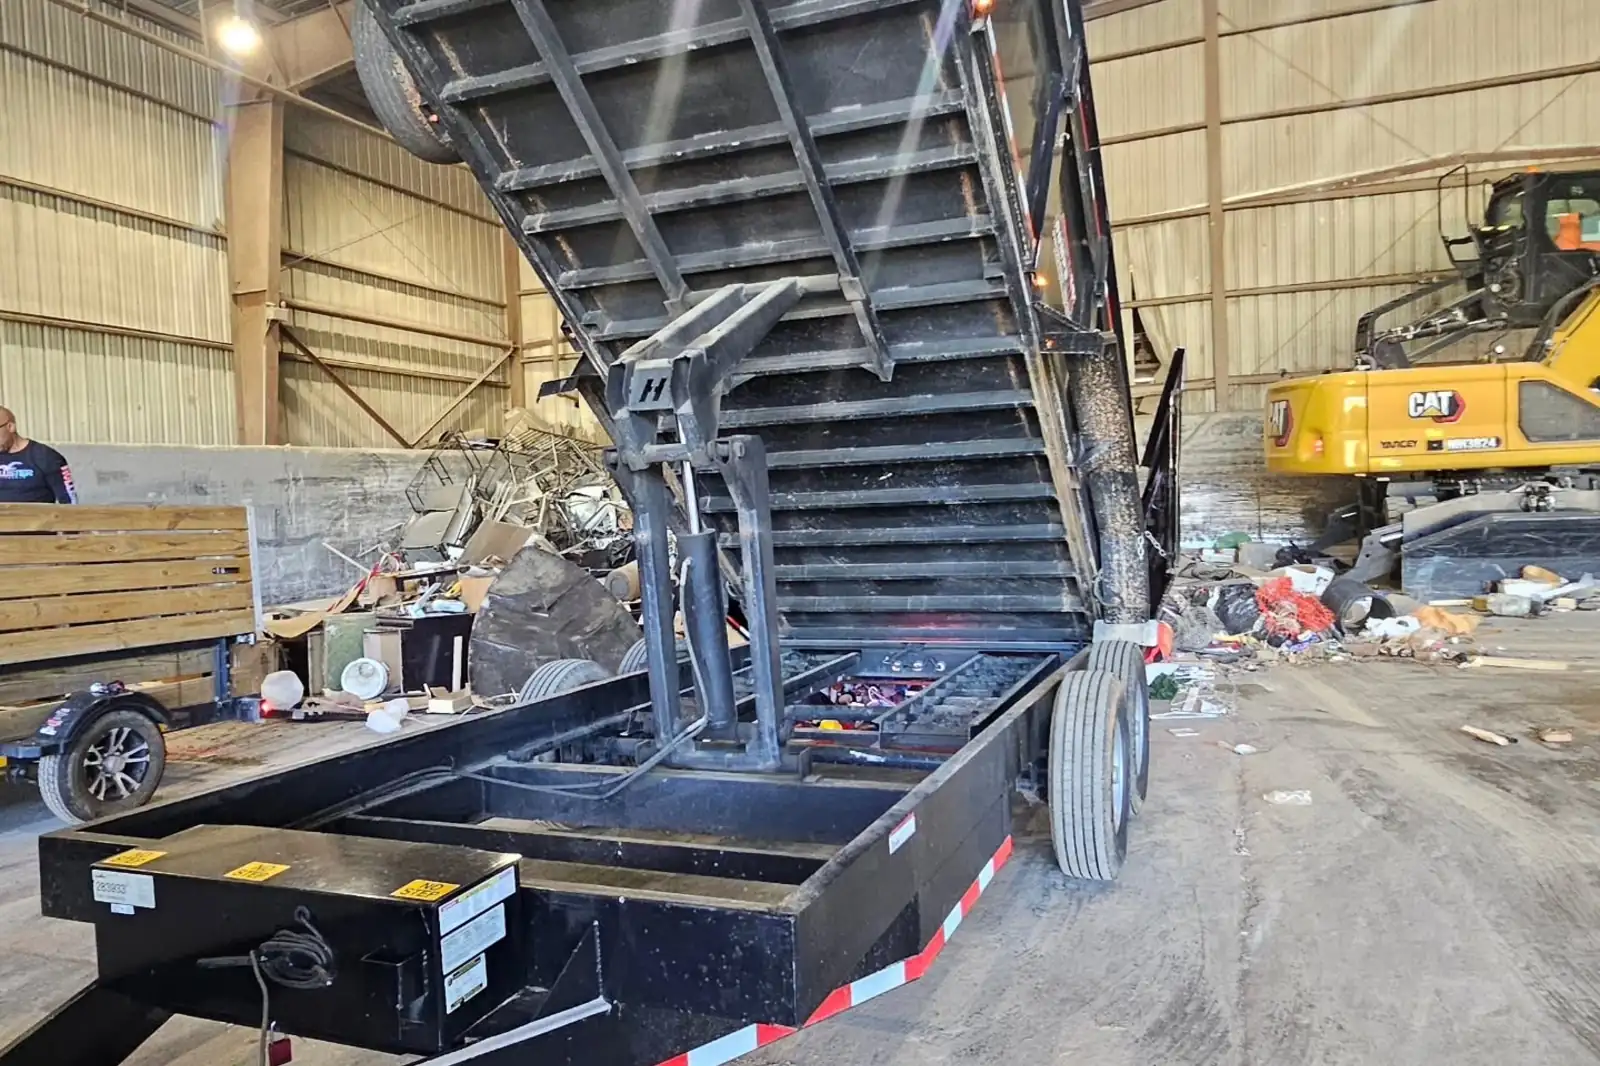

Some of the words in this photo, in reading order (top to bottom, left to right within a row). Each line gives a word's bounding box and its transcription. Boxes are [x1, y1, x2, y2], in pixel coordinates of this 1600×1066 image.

[1408, 390, 1454, 417] CAT
[420, 882, 444, 891] NO
[400, 887, 441, 898] STEP
